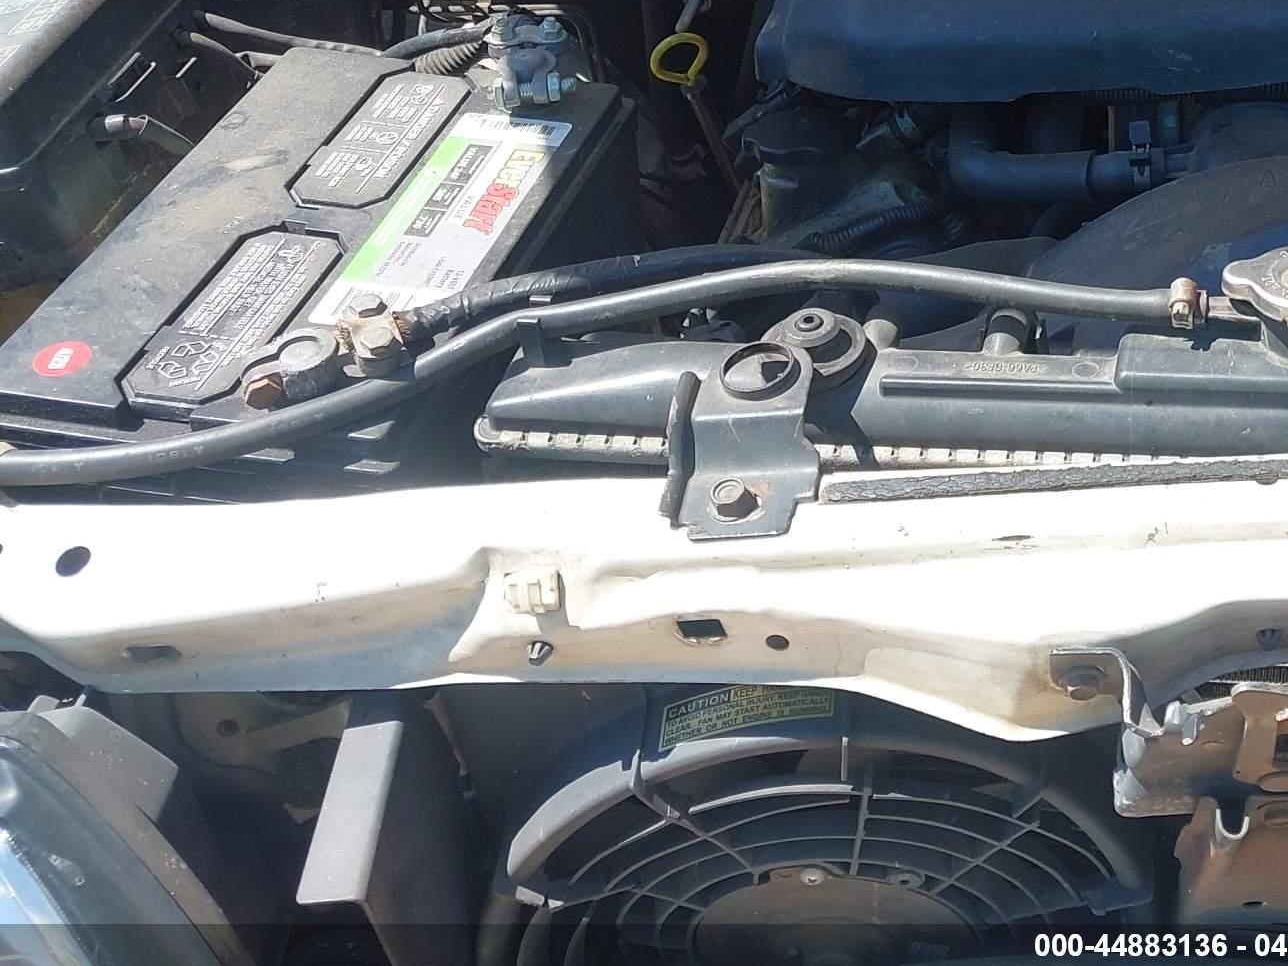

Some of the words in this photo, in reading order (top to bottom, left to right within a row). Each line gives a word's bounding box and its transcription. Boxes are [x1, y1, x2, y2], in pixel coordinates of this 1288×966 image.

[451, 195, 476, 220] VALUE
[457, 148, 546, 236] EverStart
[668, 693, 730, 719] CAUTION
[733, 686, 757, 699] KEEP
[678, 711, 701, 725] AVOID
[702, 699, 746, 718] PERSONAL
[698, 716, 713, 727] FAN
[715, 711, 732, 723] MAY
[734, 705, 759, 717] START
[762, 697, 828, 710] AUTOMATICALLY
[664, 727, 702, 745] WHETHER
[705, 722, 718, 732] OR
[721, 718, 738, 729] NOT
[742, 712, 770, 723] ENGINE
